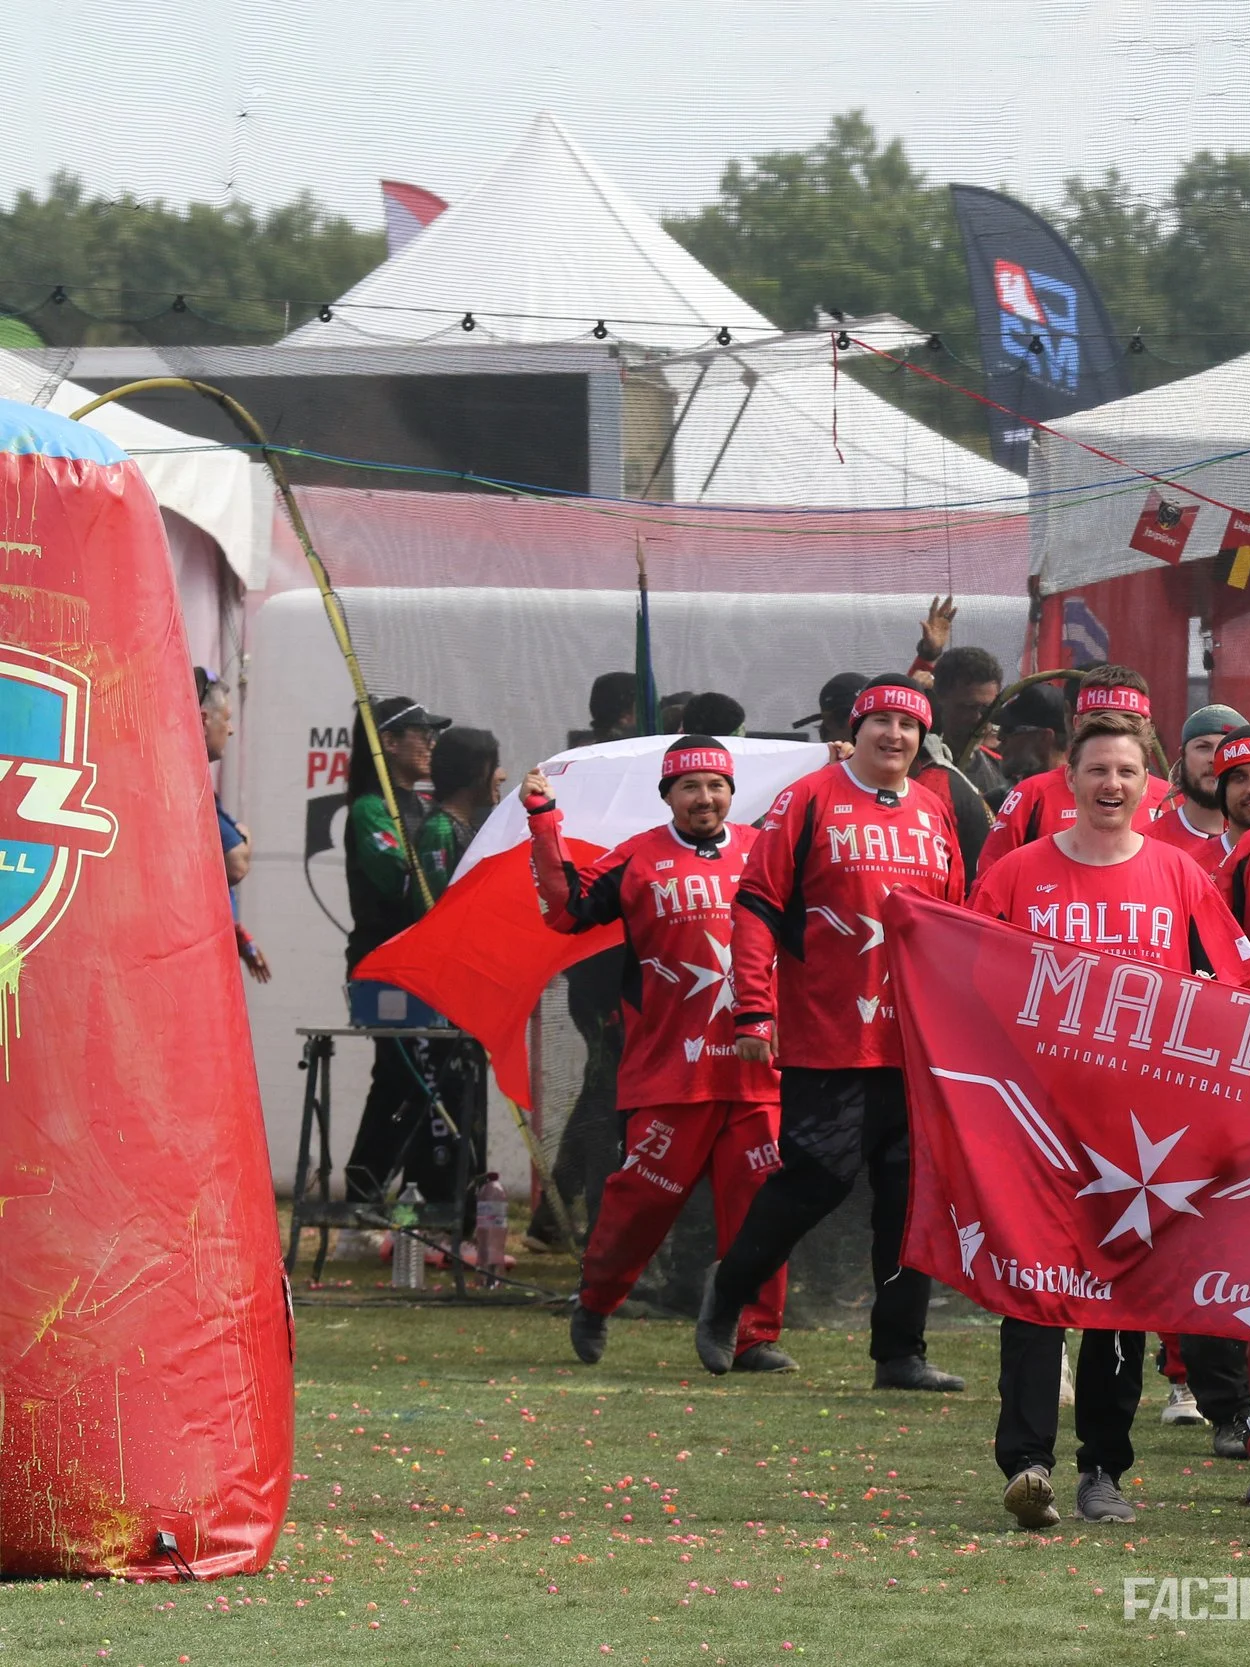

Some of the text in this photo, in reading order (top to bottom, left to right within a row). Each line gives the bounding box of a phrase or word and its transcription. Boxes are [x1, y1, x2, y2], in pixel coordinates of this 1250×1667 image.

[864, 690, 926, 714] 13 MALTA
[1087, 689, 1139, 709] MALTA
[309, 727, 350, 748] MA
[680, 752, 727, 768] MALTA
[826, 824, 949, 874] MALTA
[650, 875, 740, 918] MAL
[1028, 902, 1173, 949] MALTA
[1141, 949, 1161, 959] TEAM
[1036, 1041, 1128, 1072] NATIONAL
[1140, 1064, 1243, 1102] PAINTBALL
[636, 1127, 672, 1160] 23
[637, 1164, 684, 1194] VisitMalta
[988, 1251, 1113, 1302] VisitMalta
